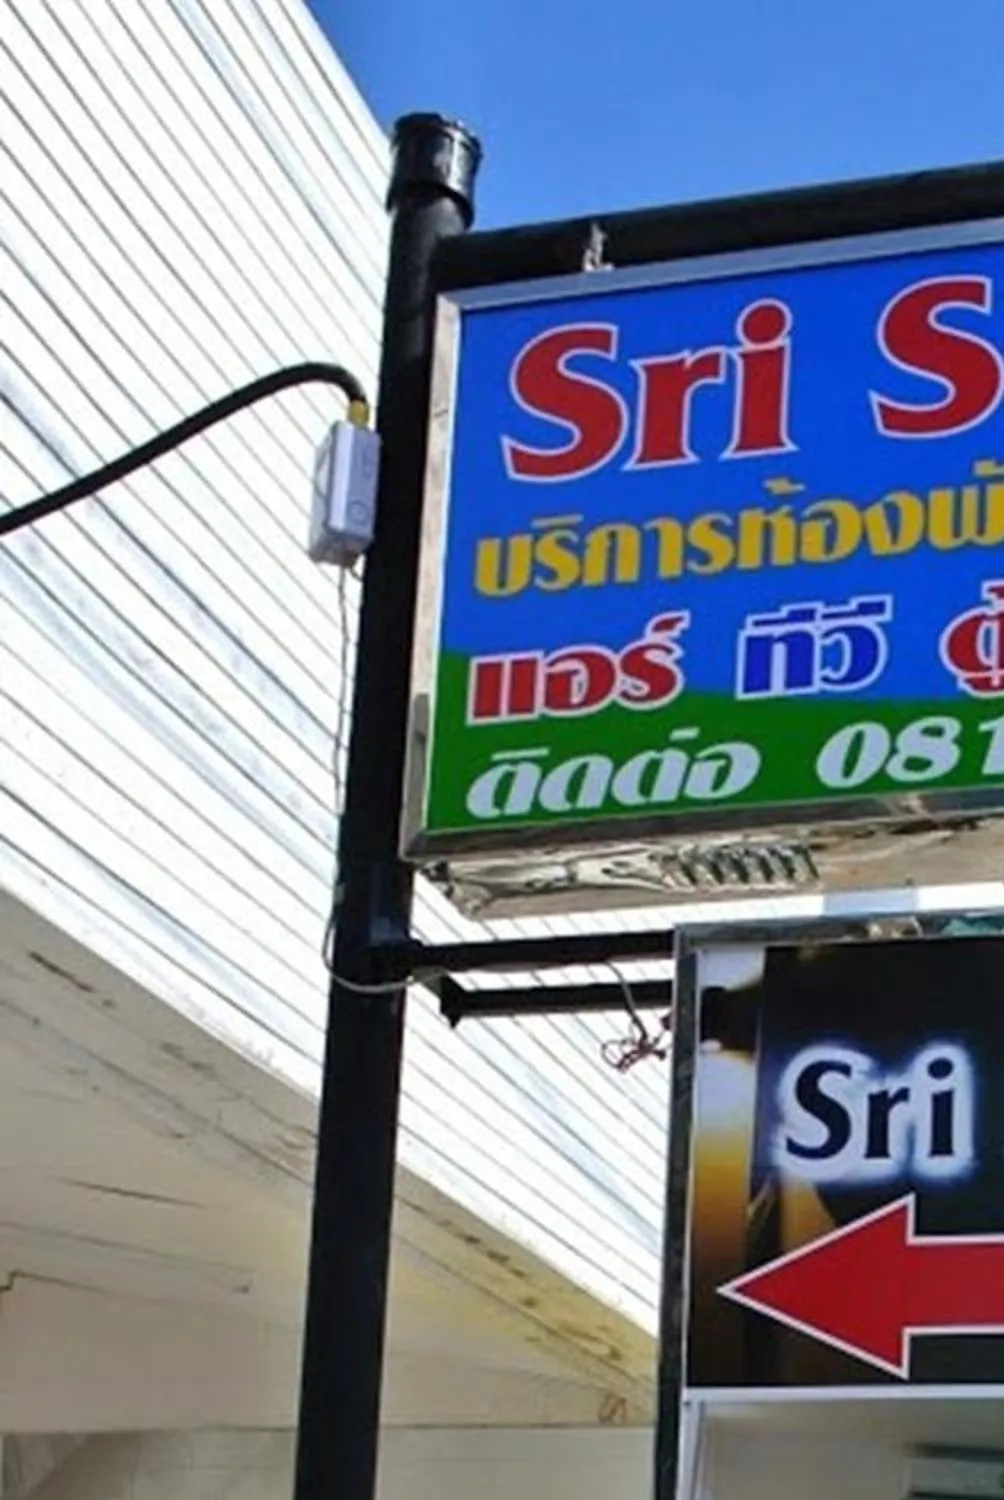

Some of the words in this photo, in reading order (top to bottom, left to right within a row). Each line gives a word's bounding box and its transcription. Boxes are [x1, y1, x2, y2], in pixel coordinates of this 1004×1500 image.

[501, 299, 797, 482] Sri
[467, 609, 690, 723] แอร์
[735, 595, 893, 699] ทีวี
[466, 727, 761, 818] ติดต่อ
[785, 1056, 956, 1161] Sri
